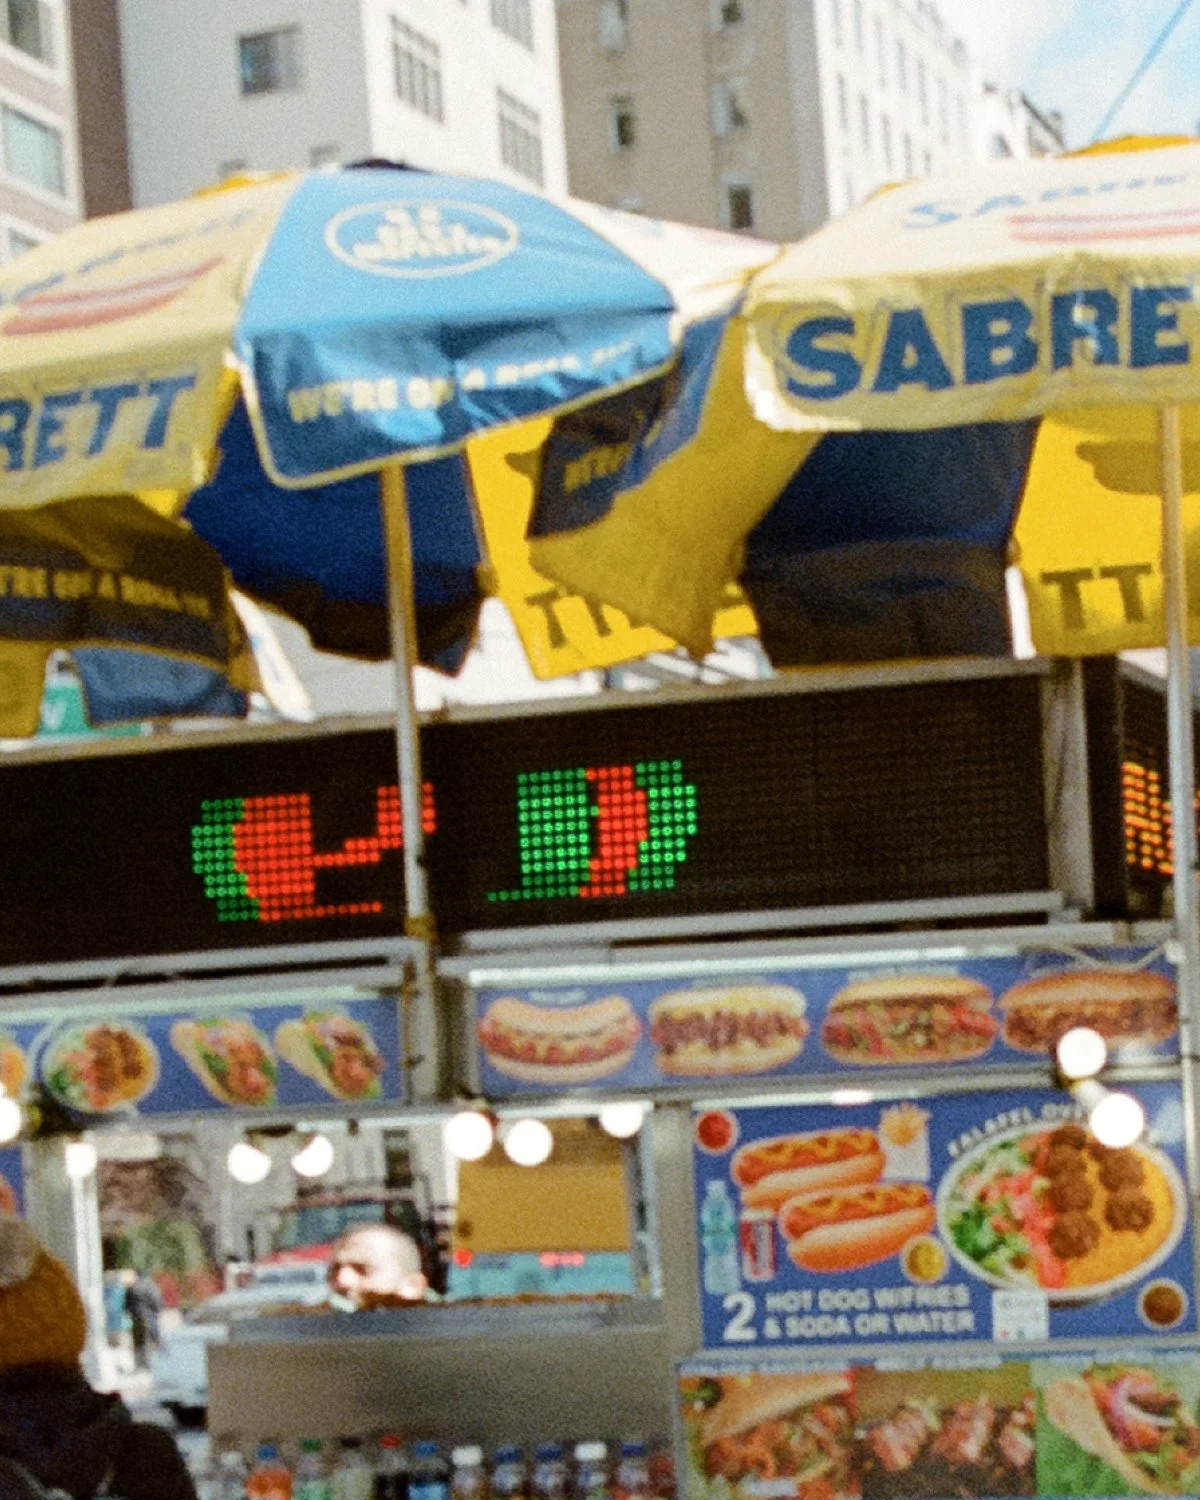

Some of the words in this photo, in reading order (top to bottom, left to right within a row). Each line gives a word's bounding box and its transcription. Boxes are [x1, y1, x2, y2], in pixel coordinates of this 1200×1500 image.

[765, 1290, 812, 1312] HOT
[818, 1288, 871, 1311] DOG
[722, 1292, 757, 1341] 2
[785, 1315, 850, 1338] SODA
[854, 1313, 890, 1335] OR
[893, 1310, 974, 1333] WATER
